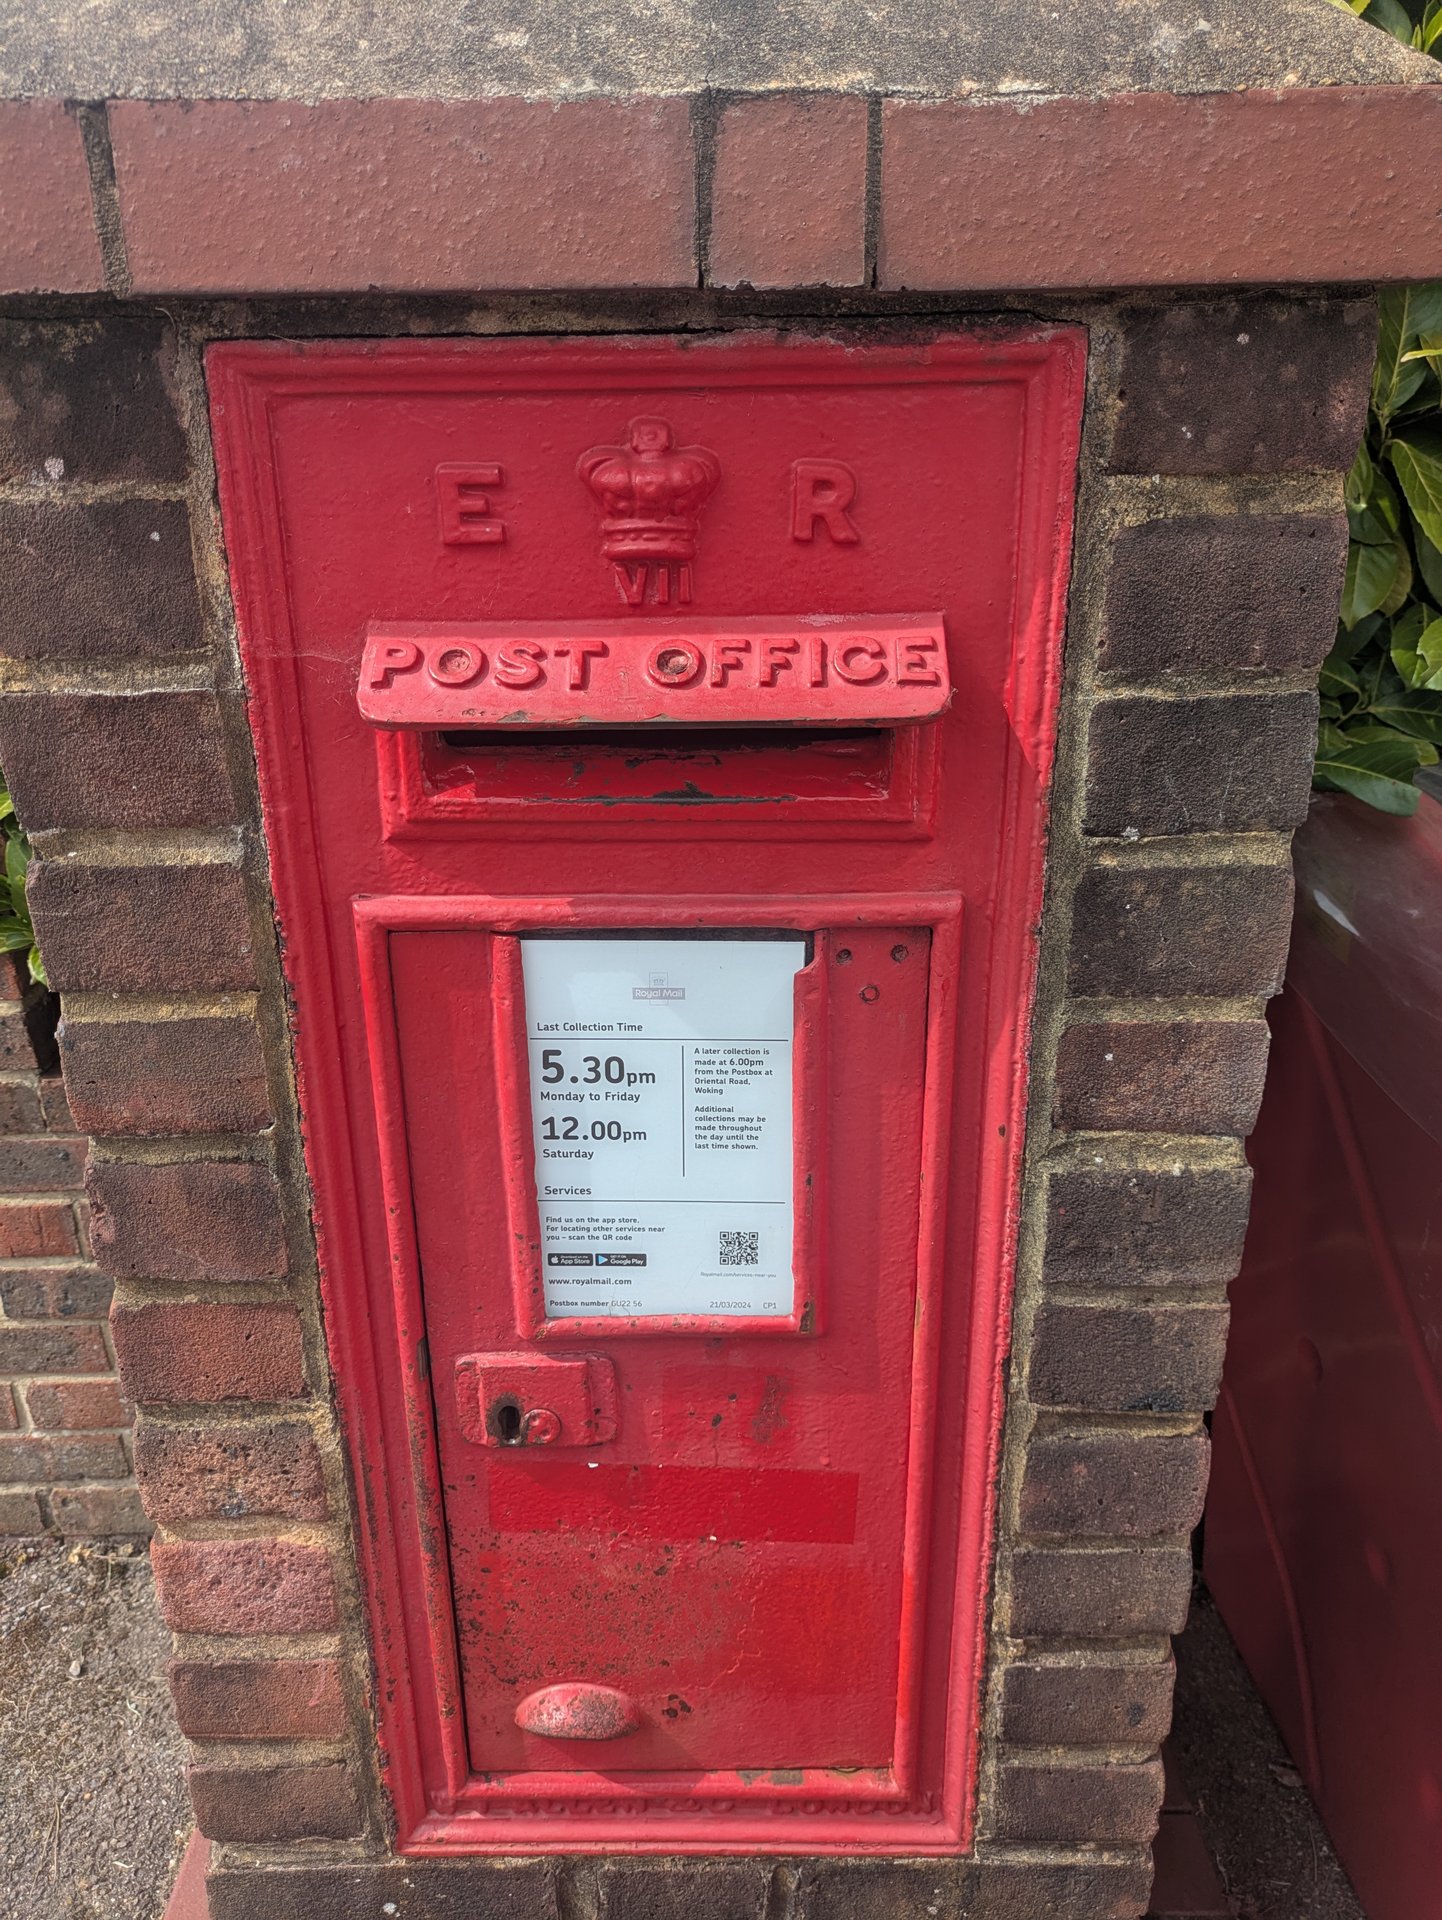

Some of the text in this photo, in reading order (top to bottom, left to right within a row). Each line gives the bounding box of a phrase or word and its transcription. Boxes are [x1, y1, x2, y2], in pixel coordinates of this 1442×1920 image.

[435, 457, 860, 545] E R
[614, 561, 695, 605] VII
[370, 636, 940, 691] POST OFFICE
[635, 989, 683, 998] Royal Mail
[537, 1022, 643, 1032] Last Collection Time
[730, 1058, 764, 1068] 6.00pm
[542, 1050, 656, 1087] 5.30pm
[729, 1078, 750, 1086] Road,
[694, 1087, 724, 1096] Woking
[540, 1092, 640, 1103] Monday to Friday
[542, 1116, 646, 1143] 12.00pm
[718, 1124, 762, 1132] throughout
[710, 1134, 724, 1142] day
[543, 1149, 594, 1160] Saturday
[544, 1186, 592, 1195] Services
[548, 1278, 632, 1286] www.royalmail.com
